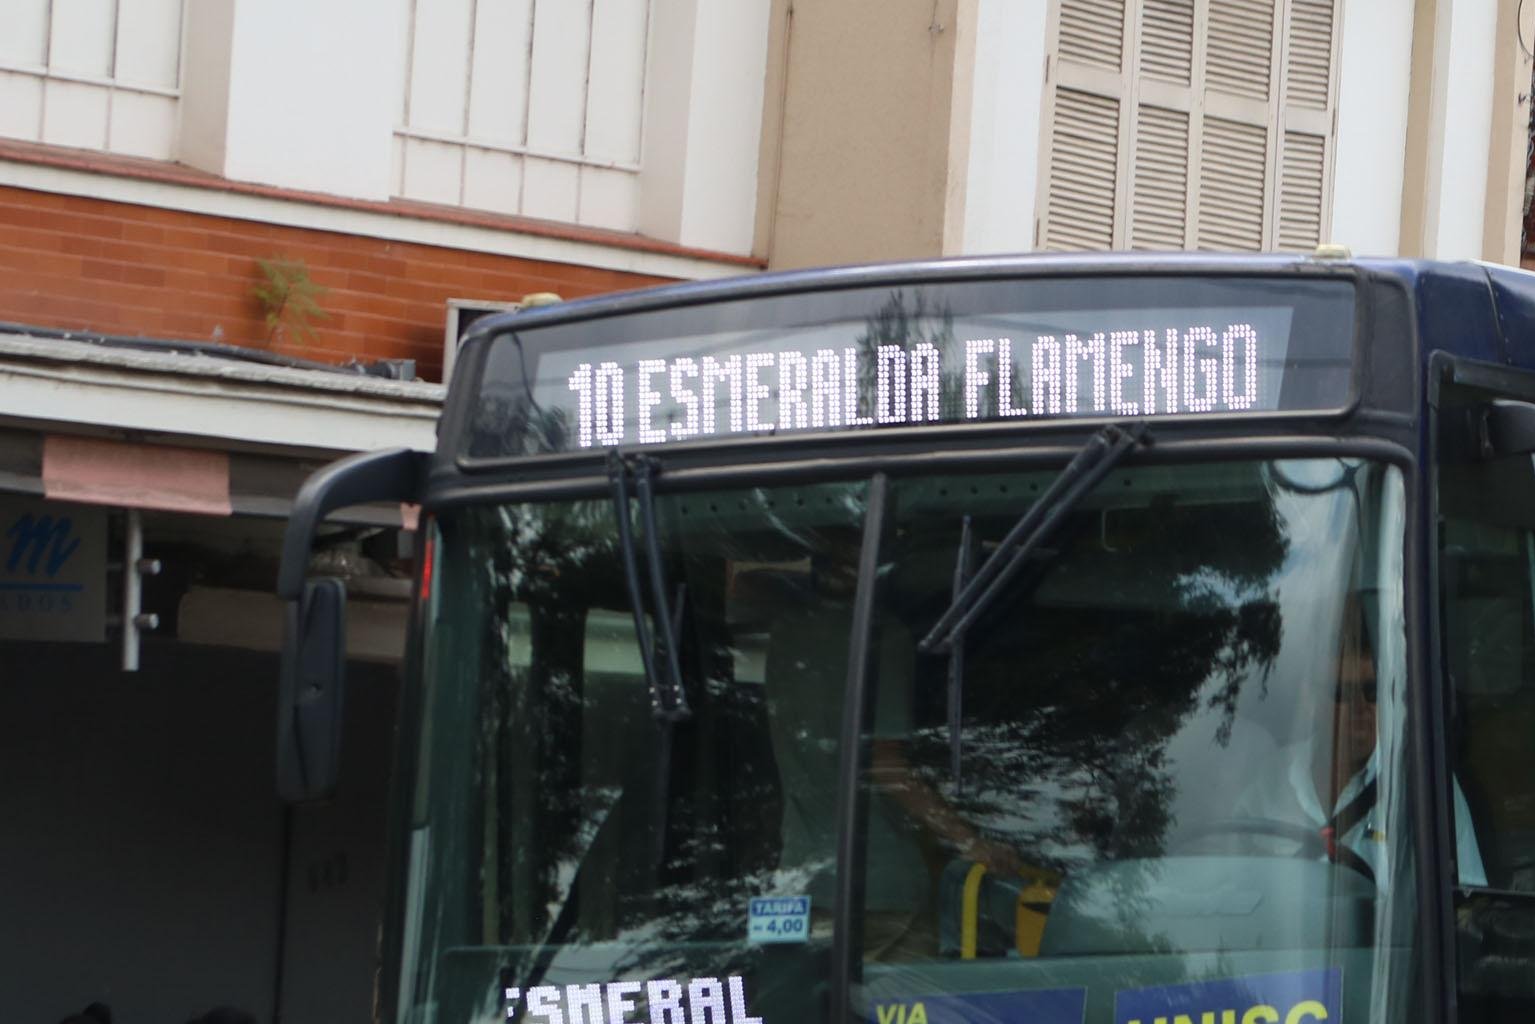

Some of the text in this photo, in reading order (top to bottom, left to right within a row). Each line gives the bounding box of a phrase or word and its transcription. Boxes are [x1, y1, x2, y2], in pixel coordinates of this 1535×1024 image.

[568, 323, 1257, 448] 10 ESMERALDA FLAMENGO
